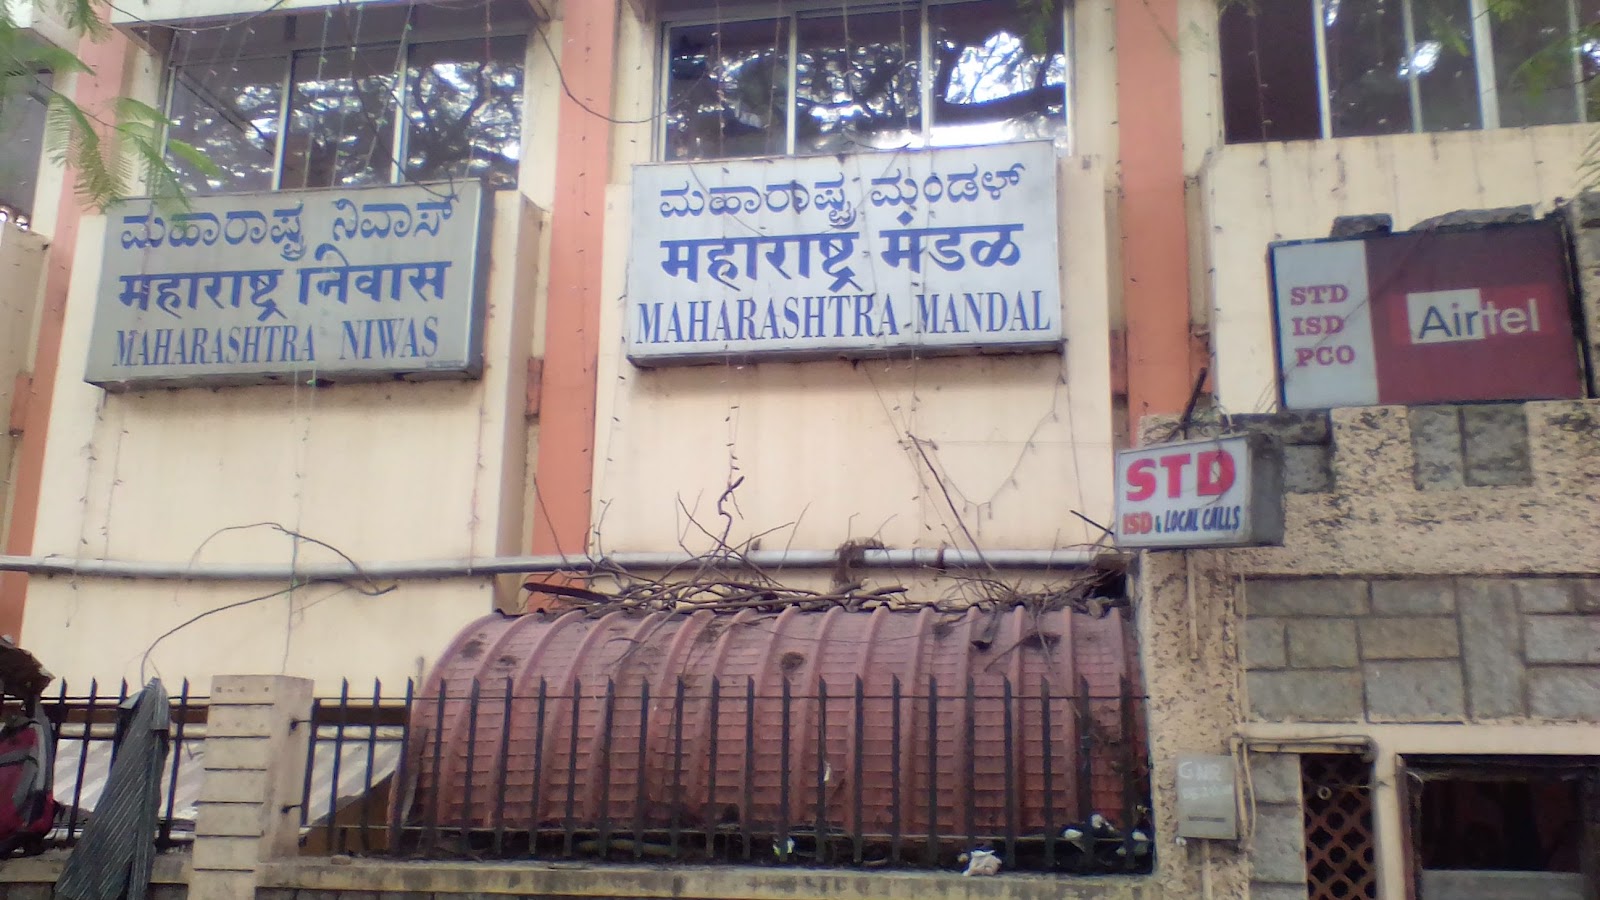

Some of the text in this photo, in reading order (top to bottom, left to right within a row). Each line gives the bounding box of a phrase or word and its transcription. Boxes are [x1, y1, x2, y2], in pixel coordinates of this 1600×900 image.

[660, 210, 1024, 293] महाराष्ट्र मंडळ
[119, 242, 452, 321] महाराष्ट्र निवास
[1290, 284, 1349, 306] STD
[636, 289, 1051, 345] MAHARASHTRA MANDAL
[1292, 315, 1345, 337] ISD
[1418, 298, 1541, 340] Airtel
[112, 315, 440, 367] MAHARASHTRA NIWAS
[1295, 345, 1356, 368] PCO
[1126, 449, 1236, 502] STD
[1123, 511, 1153, 535] ISD
[1164, 507, 1199, 533] LOCAL
[1202, 505, 1241, 532] CALLS
